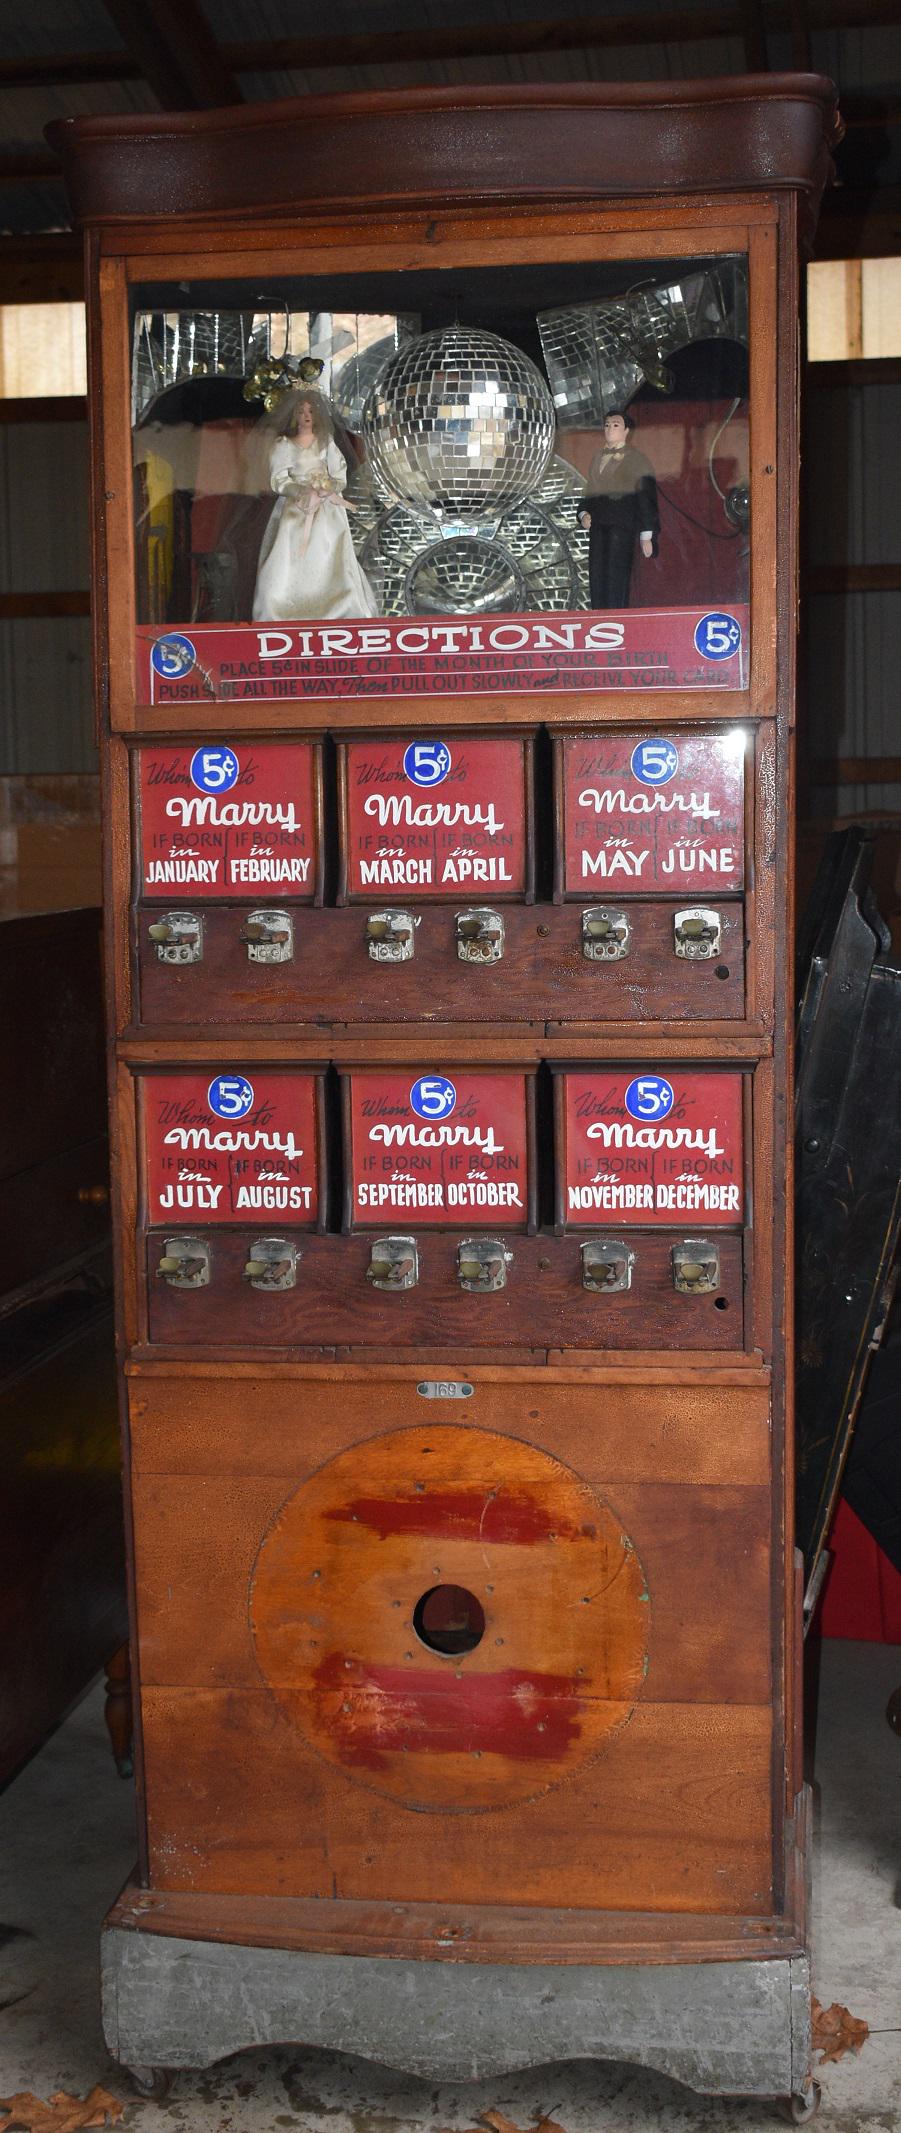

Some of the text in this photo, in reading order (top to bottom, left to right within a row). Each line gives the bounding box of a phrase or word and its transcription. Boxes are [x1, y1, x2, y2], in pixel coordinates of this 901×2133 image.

[257, 622, 625, 657] DIRECTIONS
[706, 621, 739, 653] 5¢
[219, 660, 266, 676] PLACE
[315, 658, 358, 673] SLIDE
[366, 656, 392, 672] OF
[400, 656, 426, 671] THE
[434, 655, 505, 670] MONTH
[542, 653, 597, 667] YOUR
[608, 651, 668, 667] BIRTH
[159, 684, 199, 699] PUSH
[243, 680, 267, 696] ALL
[272, 679, 297, 695] THE
[391, 675, 429, 691] PULL
[432, 674, 468, 690] OUT
[471, 673, 534, 690] SLOWLY
[629, 669, 676, 686] YOUR
[202, 754, 235, 787] 5¢
[414, 747, 448, 782] 5¢
[642, 747, 677, 779] 5¢
[166, 796, 301, 833] Marry
[364, 794, 505, 836] Marry
[578, 788, 721, 820] Marry
[153, 832, 222, 848] IF BORN
[169, 845, 201, 858] in
[235, 832, 305, 848] IF BORN
[250, 845, 275, 857] in
[358, 834, 429, 850] IF BORN
[376, 847, 407, 857] in
[442, 832, 513, 849] IF BORN
[449, 846, 480, 857] in
[603, 836, 634, 848] in
[674, 836, 707, 847] in
[146, 859, 220, 884] JANUARY
[230, 858, 311, 884] FEBRUARY
[359, 859, 432, 885] MARCH
[442, 857, 513, 883] APRIL
[582, 849, 650, 877] MAY
[662, 848, 735, 873] JUNE
[219, 1082, 252, 1114] 5¢
[420, 1082, 454, 1114] 5¢
[454, 1094, 480, 1118] to
[637, 1082, 671, 1114] 5¢
[158, 1099, 277, 1126] Whom to
[164, 1127, 303, 1161] Marry
[368, 1123, 505, 1155] Marry
[586, 1122, 725, 1159] Marry
[161, 1157, 218, 1171] IF BORN
[236, 1159, 300, 1174] IF BORN
[257, 1168, 290, 1181] in
[363, 1156, 432, 1171] IF BORN
[449, 1154, 519, 1170] IF BORN
[466, 1168, 489, 1180] in
[577, 1158, 648, 1174] IF BORN
[663, 1158, 734, 1175] IF BORN
[178, 1168, 212, 1183] in
[390, 1170, 417, 1182] in
[590, 1171, 621, 1183] in
[675, 1172, 704, 1183] in
[159, 1184, 224, 1209] JULY
[236, 1186, 313, 1209] AUGUST
[358, 1183, 444, 1207] SEPTEMBER
[447, 1182, 524, 1207] OCTOBER
[568, 1184, 654, 1210] NOVEMBER
[656, 1183, 741, 1211] DECEMBER
[434, 1383, 457, 1397] 169
